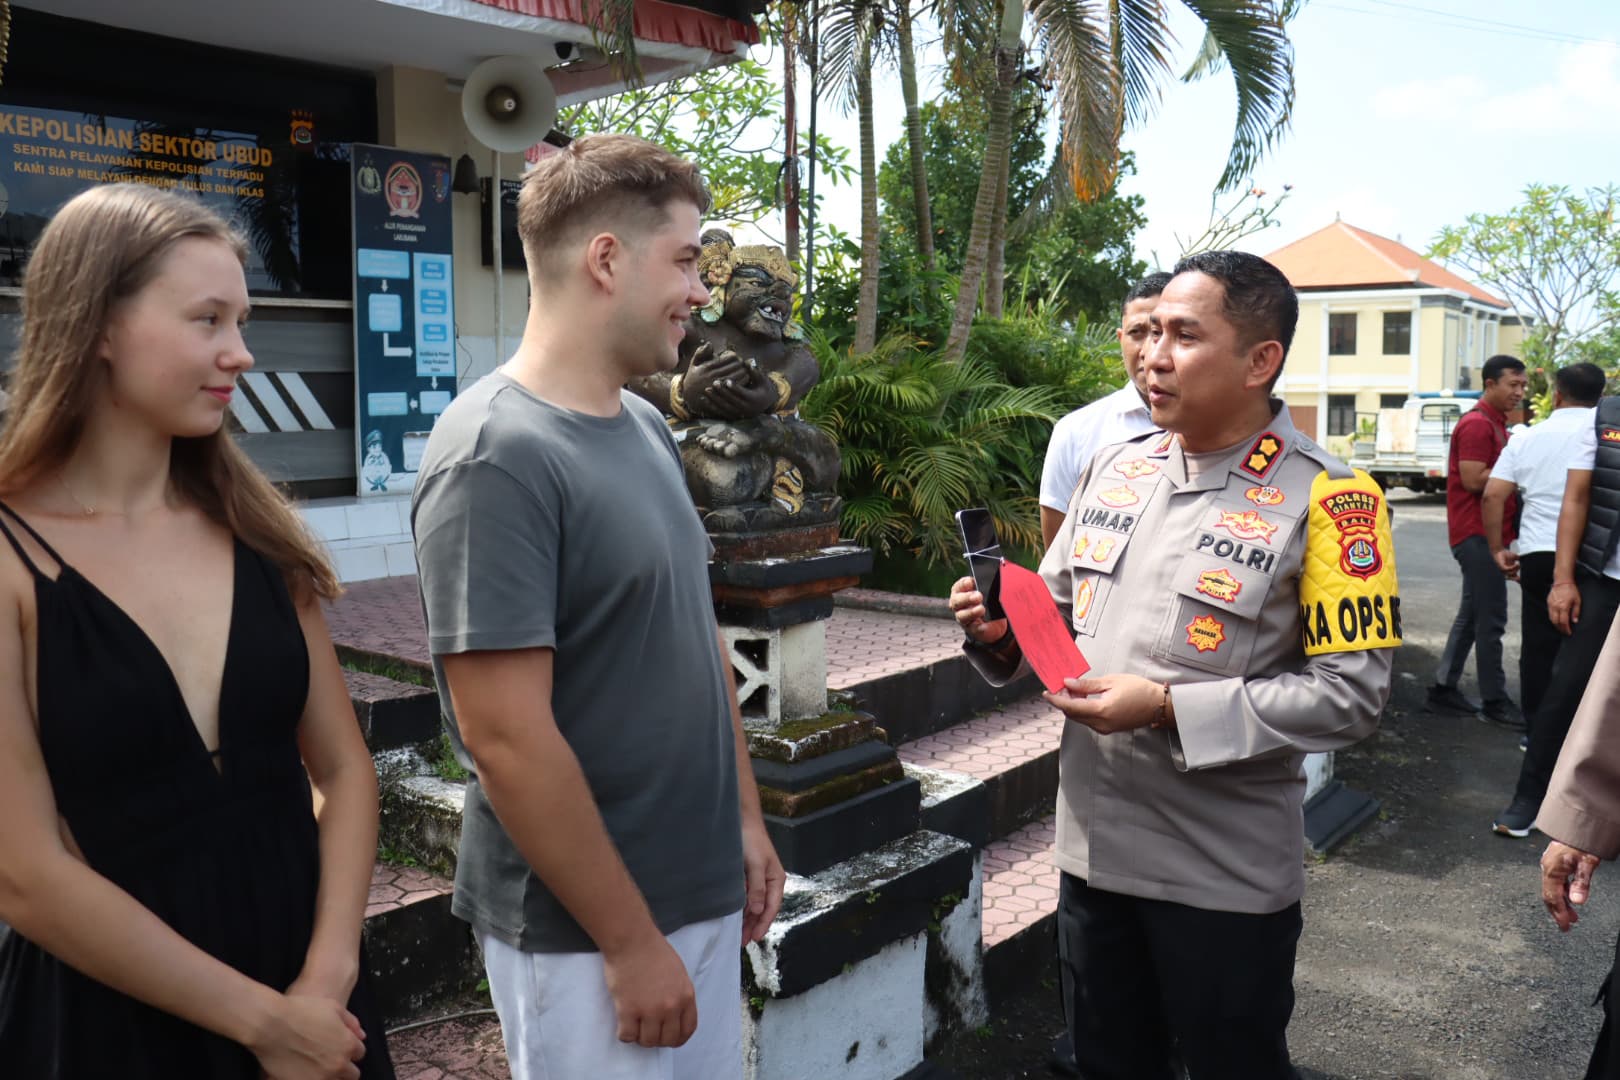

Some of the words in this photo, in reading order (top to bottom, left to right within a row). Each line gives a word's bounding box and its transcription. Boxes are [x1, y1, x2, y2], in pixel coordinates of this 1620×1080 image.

[0, 112, 133, 150] KEPOLISIAN
[140, 132, 217, 160] SEKTOR
[223, 143, 272, 167] UBUD
[14, 143, 66, 159] SENTRA
[70, 150, 142, 168] PELAYANAN
[146, 159, 213, 176] KEPOLISIAN
[216, 168, 264, 182] TERPADU
[14, 161, 45, 175] KAMI
[48, 165, 74, 177] SIAP
[78, 169, 132, 184] MELAYANI
[182, 180, 212, 192] TULUS
[215, 184, 234, 195] DAN
[237, 186, 264, 198] IKLAS
[1326, 493, 1375, 509] POLRES
[1333, 502, 1373, 514] GIANYAR
[1081, 508, 1134, 533] UMAR
[1341, 517, 1371, 527] BALI
[1197, 533, 1275, 573] POLRI
[1301, 601, 1332, 648] KA
[1338, 594, 1387, 643] OPS
